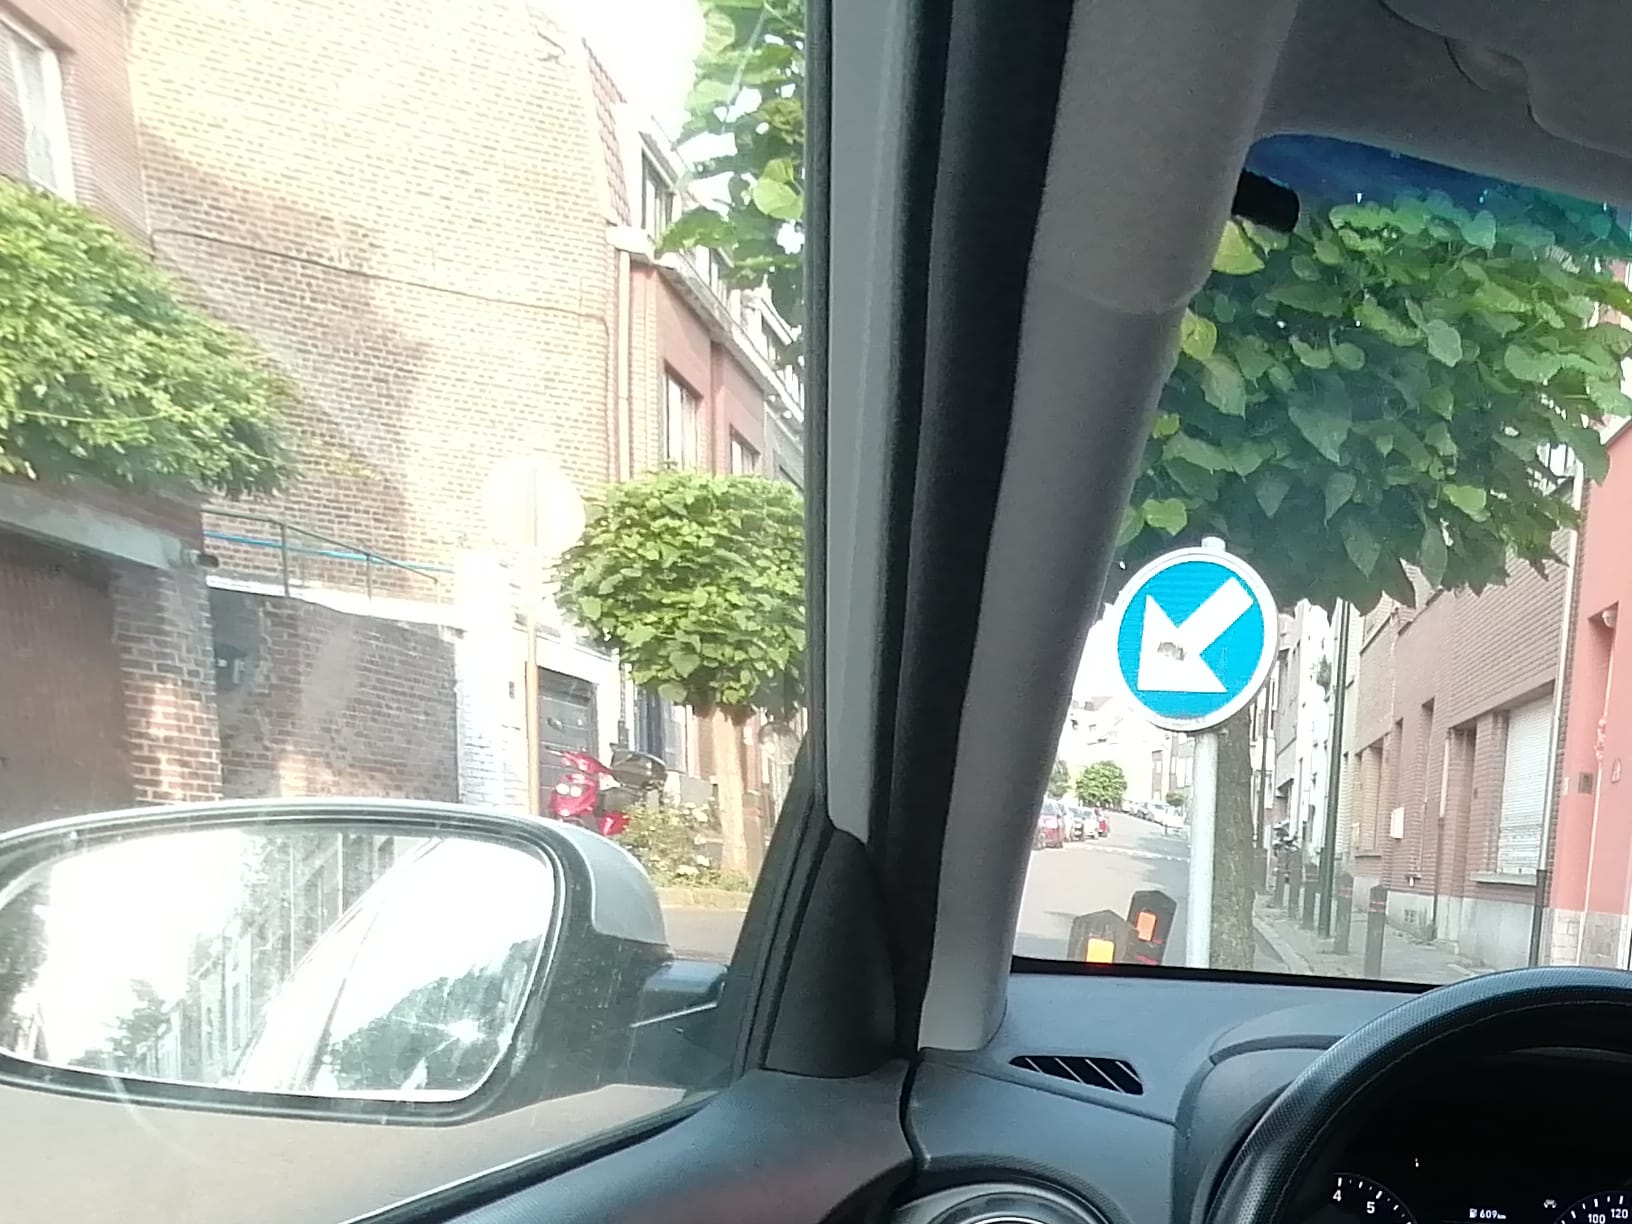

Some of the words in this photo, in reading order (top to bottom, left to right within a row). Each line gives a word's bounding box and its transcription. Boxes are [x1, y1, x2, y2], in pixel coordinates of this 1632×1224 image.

[1332, 1189, 1342, 1202] 4
[1366, 1201, 1375, 1214] 5
[1610, 1208, 1629, 1219] 120
[1588, 1213, 1606, 1224] 100
